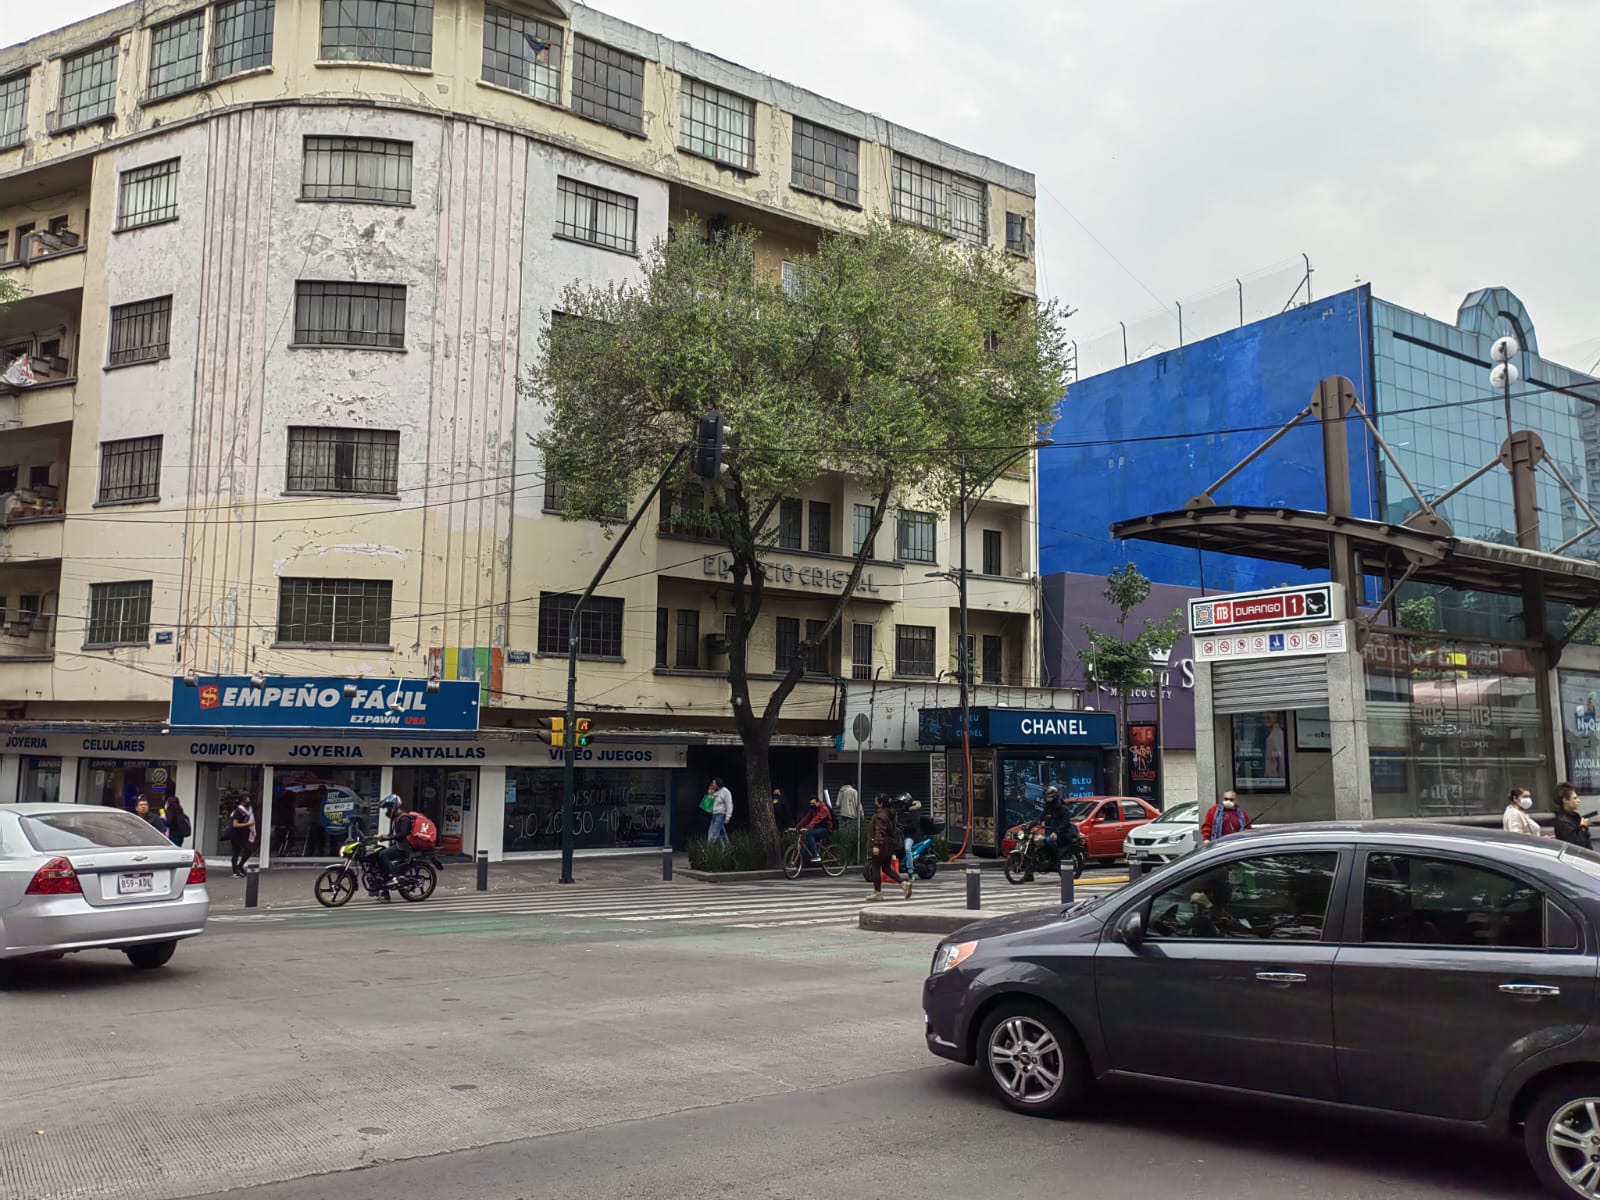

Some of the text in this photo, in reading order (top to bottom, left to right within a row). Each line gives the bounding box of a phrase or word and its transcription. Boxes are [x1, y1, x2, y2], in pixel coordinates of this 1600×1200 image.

[799, 566, 880, 593] CRISAL
[1216, 606, 1229, 621] MB
[1235, 603, 1281, 616] DURANGO
[222, 683, 341, 708] EMPEÑO
[350, 685, 427, 711] FÁCIL
[1110, 687, 1172, 699] MICO CTY
[1021, 718, 1088, 735] CHANEL
[5, 737, 48, 748] JOYERIA
[82, 739, 145, 751] CELULARES
[190, 743, 256, 756] COMPUTO
[288, 745, 363, 758] JOYERIA
[390, 746, 486, 759] PANTALLAS
[549, 749, 653, 761] VIEO JUEGOS
